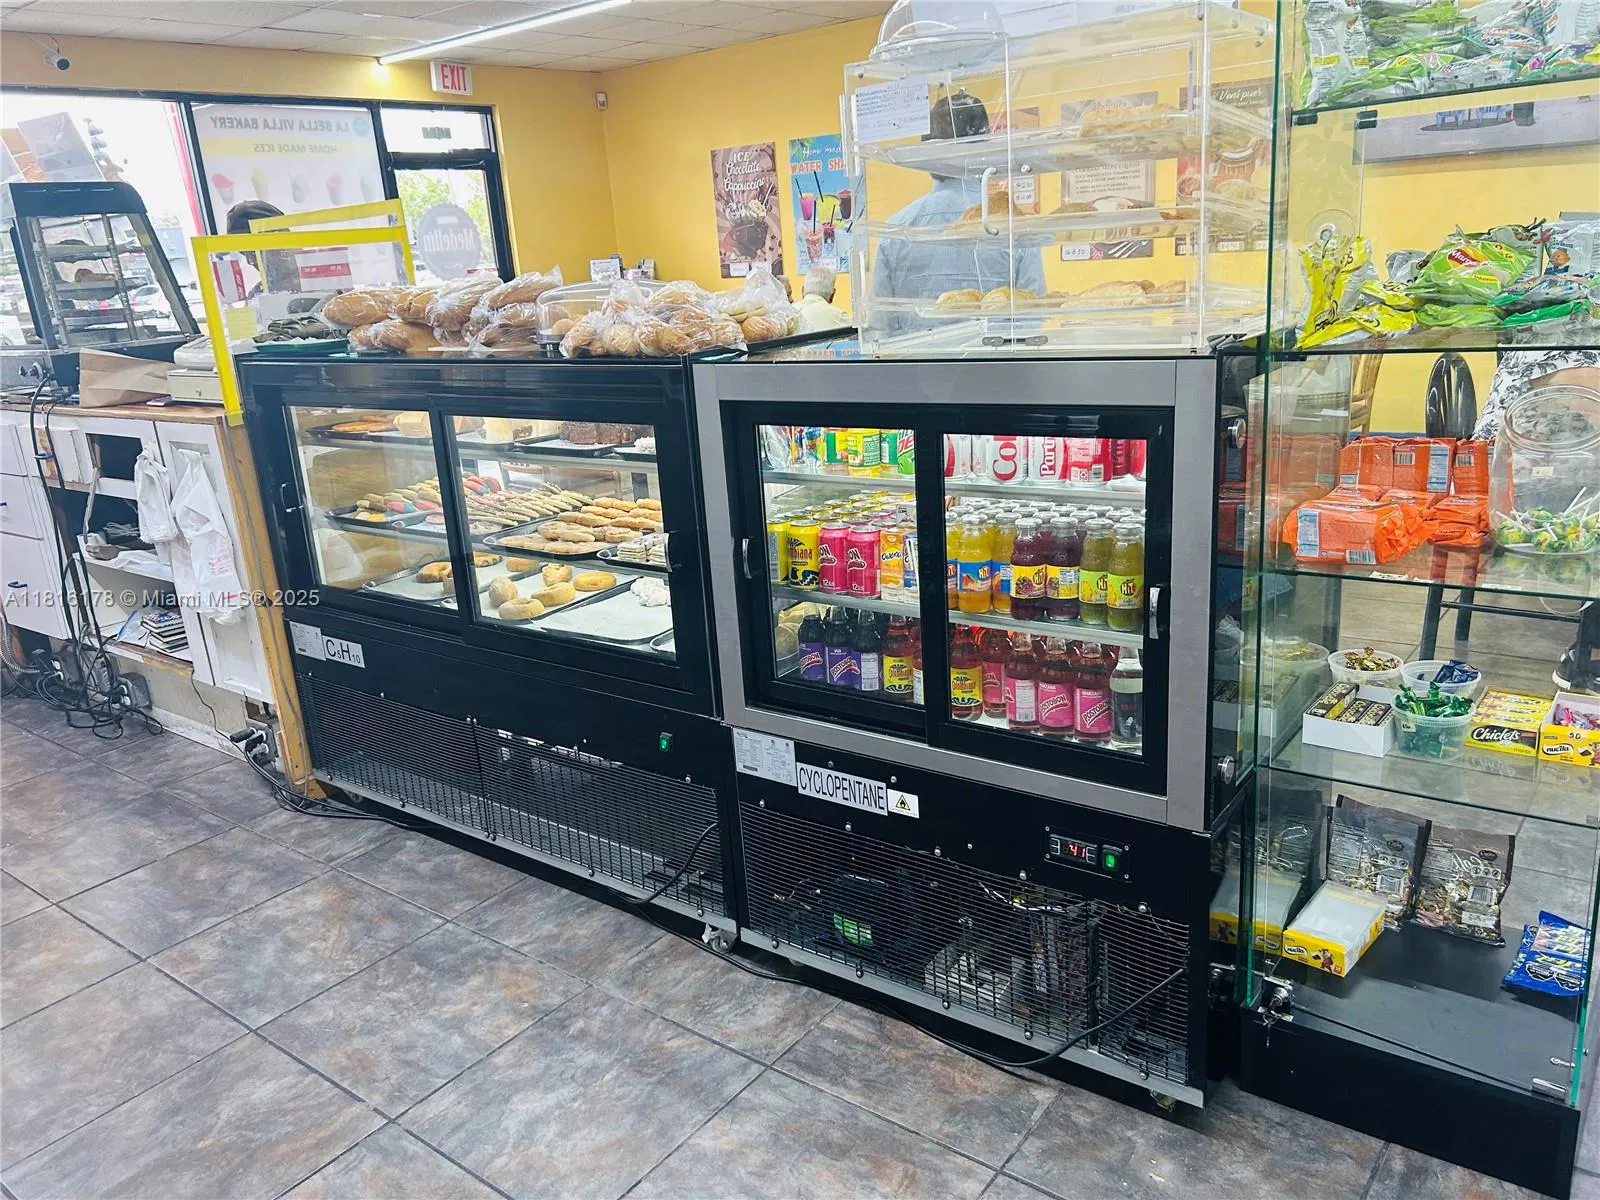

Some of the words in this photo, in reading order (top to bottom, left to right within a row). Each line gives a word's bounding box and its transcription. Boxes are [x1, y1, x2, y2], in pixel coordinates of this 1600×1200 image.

[440, 63, 468, 92] EXIT
[733, 152, 751, 163] ICE
[790, 160, 821, 174] WATER
[828, 157, 848, 170] SHA
[1472, 727, 1521, 741] Chiclets
[799, 766, 886, 811] CYCLOPENTANE
[1069, 844, 1086, 858] 41
